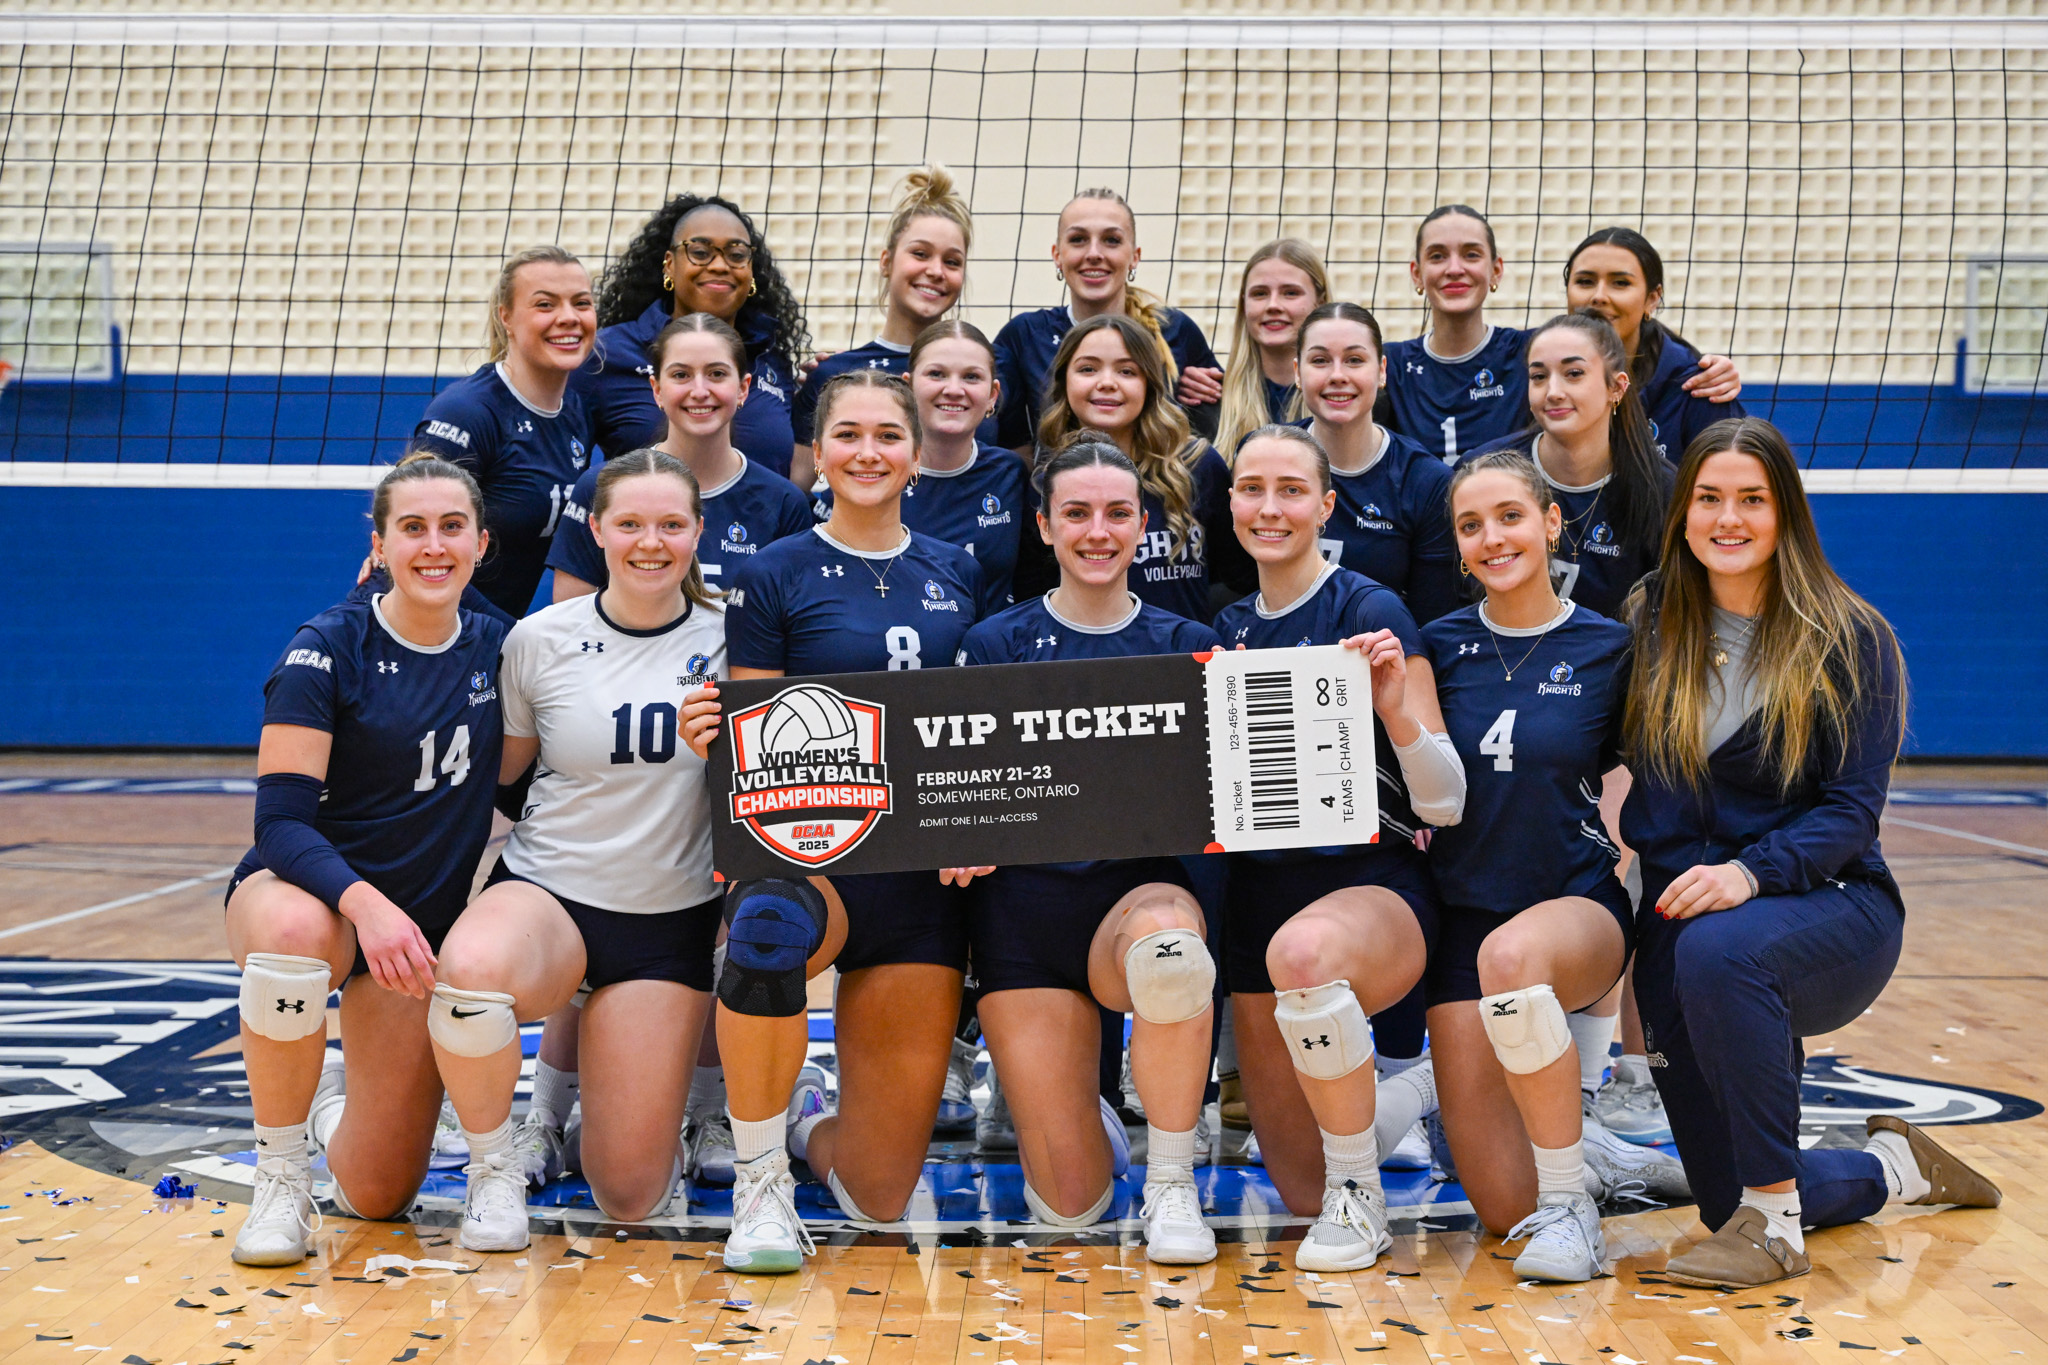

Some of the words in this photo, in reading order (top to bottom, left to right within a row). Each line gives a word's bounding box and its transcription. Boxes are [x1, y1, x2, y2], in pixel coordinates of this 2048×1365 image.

[426, 420, 471, 449] OCAA
[721, 539, 757, 555] KNIGHTS
[1144, 564, 1202, 583] VOLLEYBALL
[921, 599, 959, 612] KNIGHTS
[885, 626, 922, 671] 8
[285, 649, 333, 673] OCAA
[1335, 677, 1348, 707] GRIT
[1537, 682, 1582, 697] KNIGHTS
[913, 713, 997, 748] VIP
[1012, 702, 1186, 742] TICKET
[1226, 675, 1240, 751] 123-456-7890
[610, 701, 677, 765] 10
[1479, 709, 1517, 772] 4
[414, 724, 471, 792] 14
[758, 747, 860, 769] WOMEN'S
[1317, 744, 1333, 752] 1
[1338, 721, 1352, 771] CHAMP
[738, 765, 882, 792] VOLLEYBALL
[916, 769, 1003, 787] FEBRUARY
[1006, 765, 1052, 782] 21-23
[738, 787, 886, 815] CHAMPIONSHIP
[918, 788, 1011, 805] SOMEWHERE,
[1014, 784, 1080, 799] ONTARIO
[1233, 780, 1243, 812] Ticket
[1320, 795, 1336, 808] 4
[1342, 779, 1354, 823] TEAMS
[791, 824, 835, 839] OCAA
[919, 817, 949, 828] ADMIT
[951, 816, 971, 825] ONE
[979, 812, 1038, 824] ALL-ACCESS
[1235, 813, 1245, 832] No.
[798, 840, 829, 850] 2025
